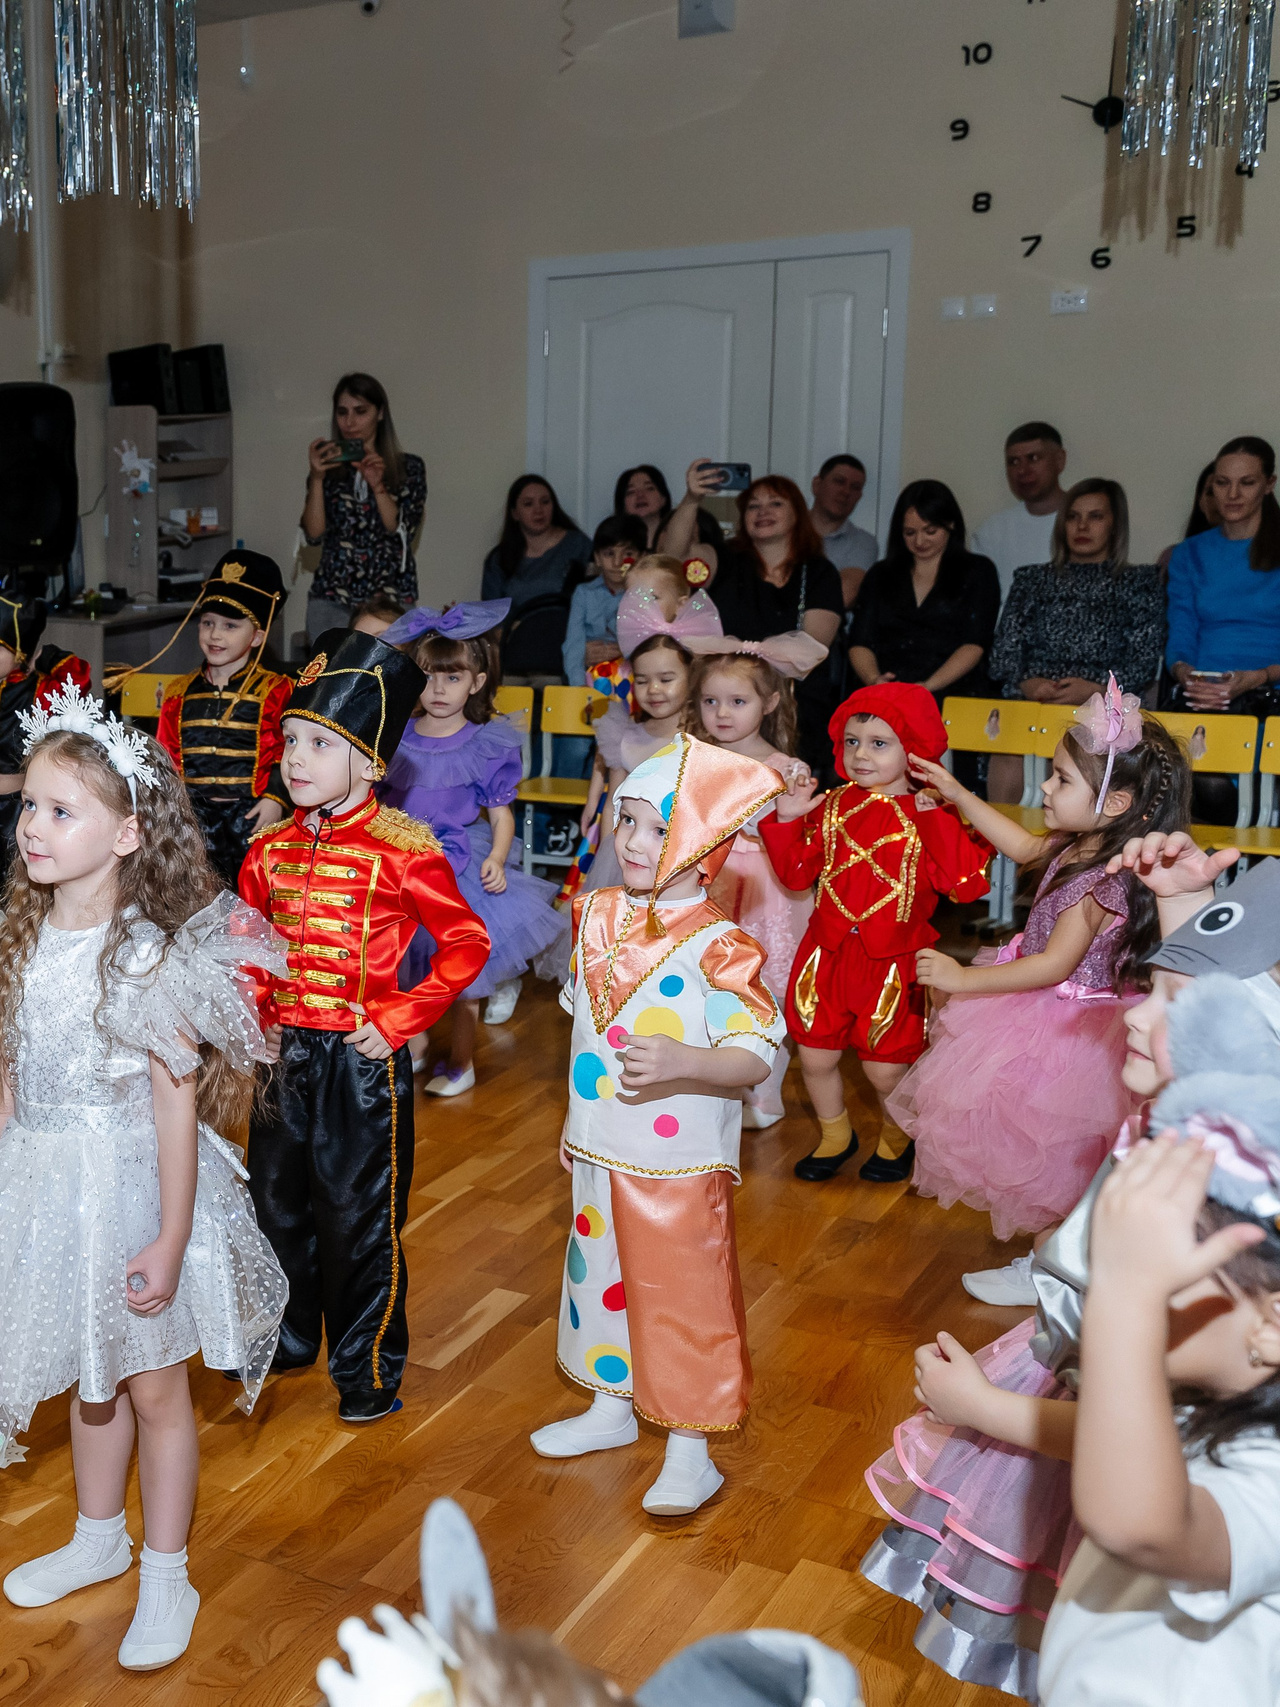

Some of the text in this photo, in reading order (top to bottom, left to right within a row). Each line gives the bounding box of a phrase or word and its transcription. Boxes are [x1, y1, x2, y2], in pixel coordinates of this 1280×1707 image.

[961, 42, 993, 67] 10
[949, 118, 970, 142] 9
[971, 191, 992, 214] 8
[1175, 214, 1197, 239] 5
[1020, 234, 1042, 258] 7
[1090, 246, 1112, 270] 6
